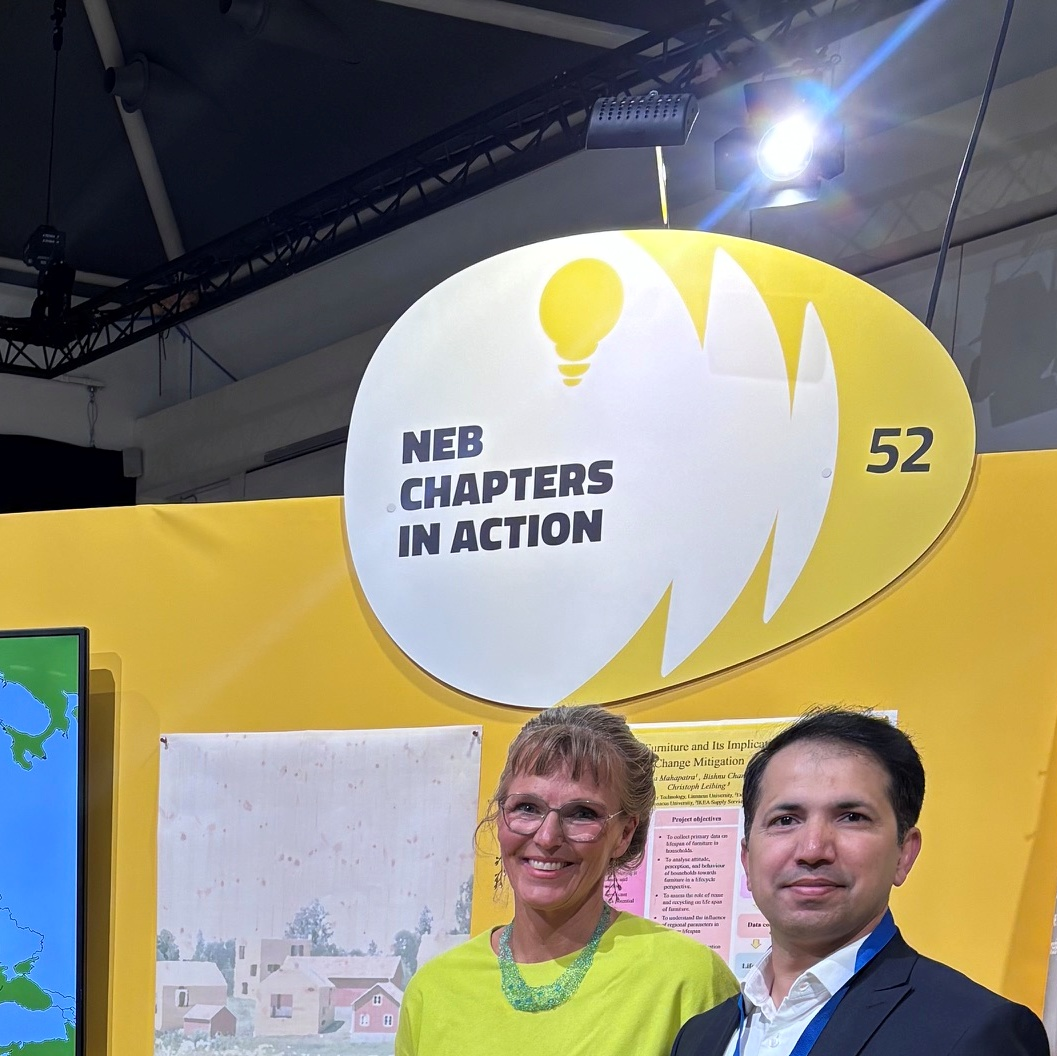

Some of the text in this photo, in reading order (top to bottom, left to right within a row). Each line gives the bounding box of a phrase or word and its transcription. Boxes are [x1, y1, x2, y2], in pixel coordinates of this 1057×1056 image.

[402, 425, 483, 464] NEB
[866, 426, 935, 474] 52
[400, 460, 613, 511] CHAPTERS
[398, 509, 603, 558] IN ACTION
[655, 755, 744, 769] Change Mitigation
[691, 742, 709, 752] and
[712, 741, 725, 751] Its
[667, 782, 700, 791] Christoph
